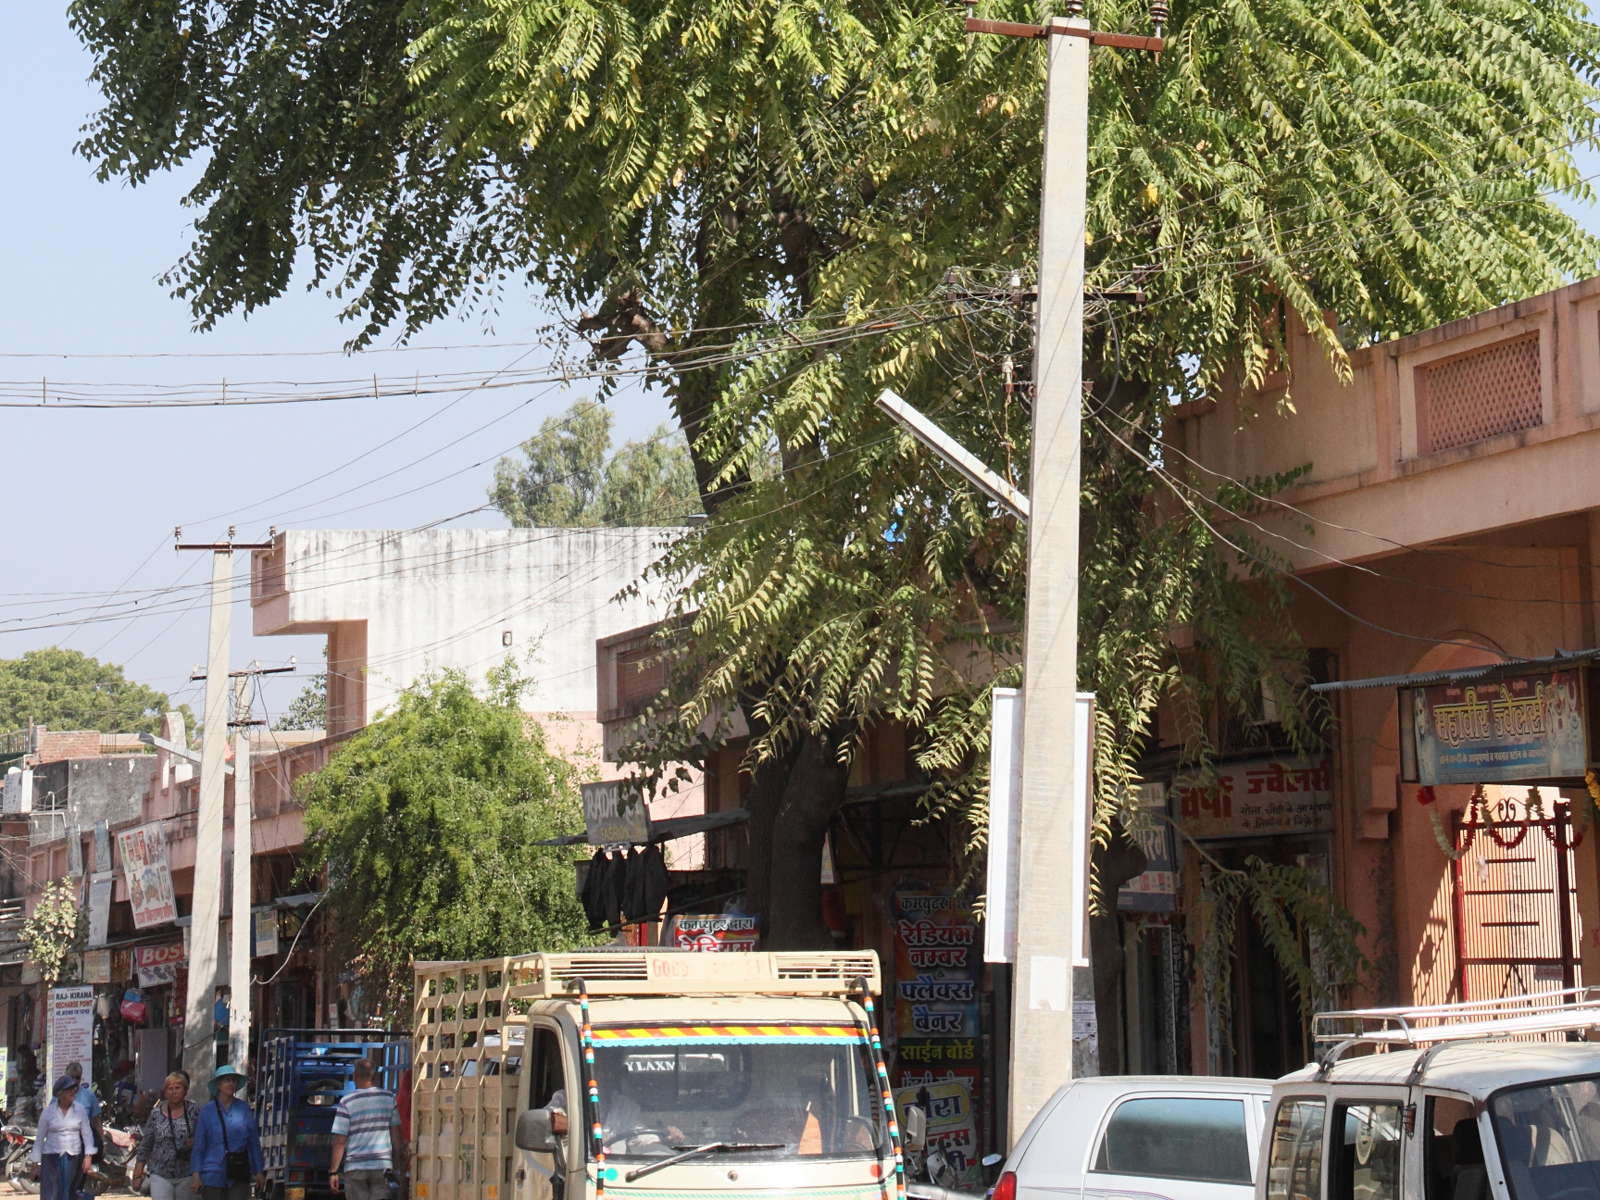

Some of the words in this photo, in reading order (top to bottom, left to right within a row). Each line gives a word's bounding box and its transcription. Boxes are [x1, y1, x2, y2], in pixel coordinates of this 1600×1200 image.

[900, 920, 974, 945] रेडियम
[909, 947, 967, 967] नम्बर
[912, 1005, 962, 1032] बैनर
